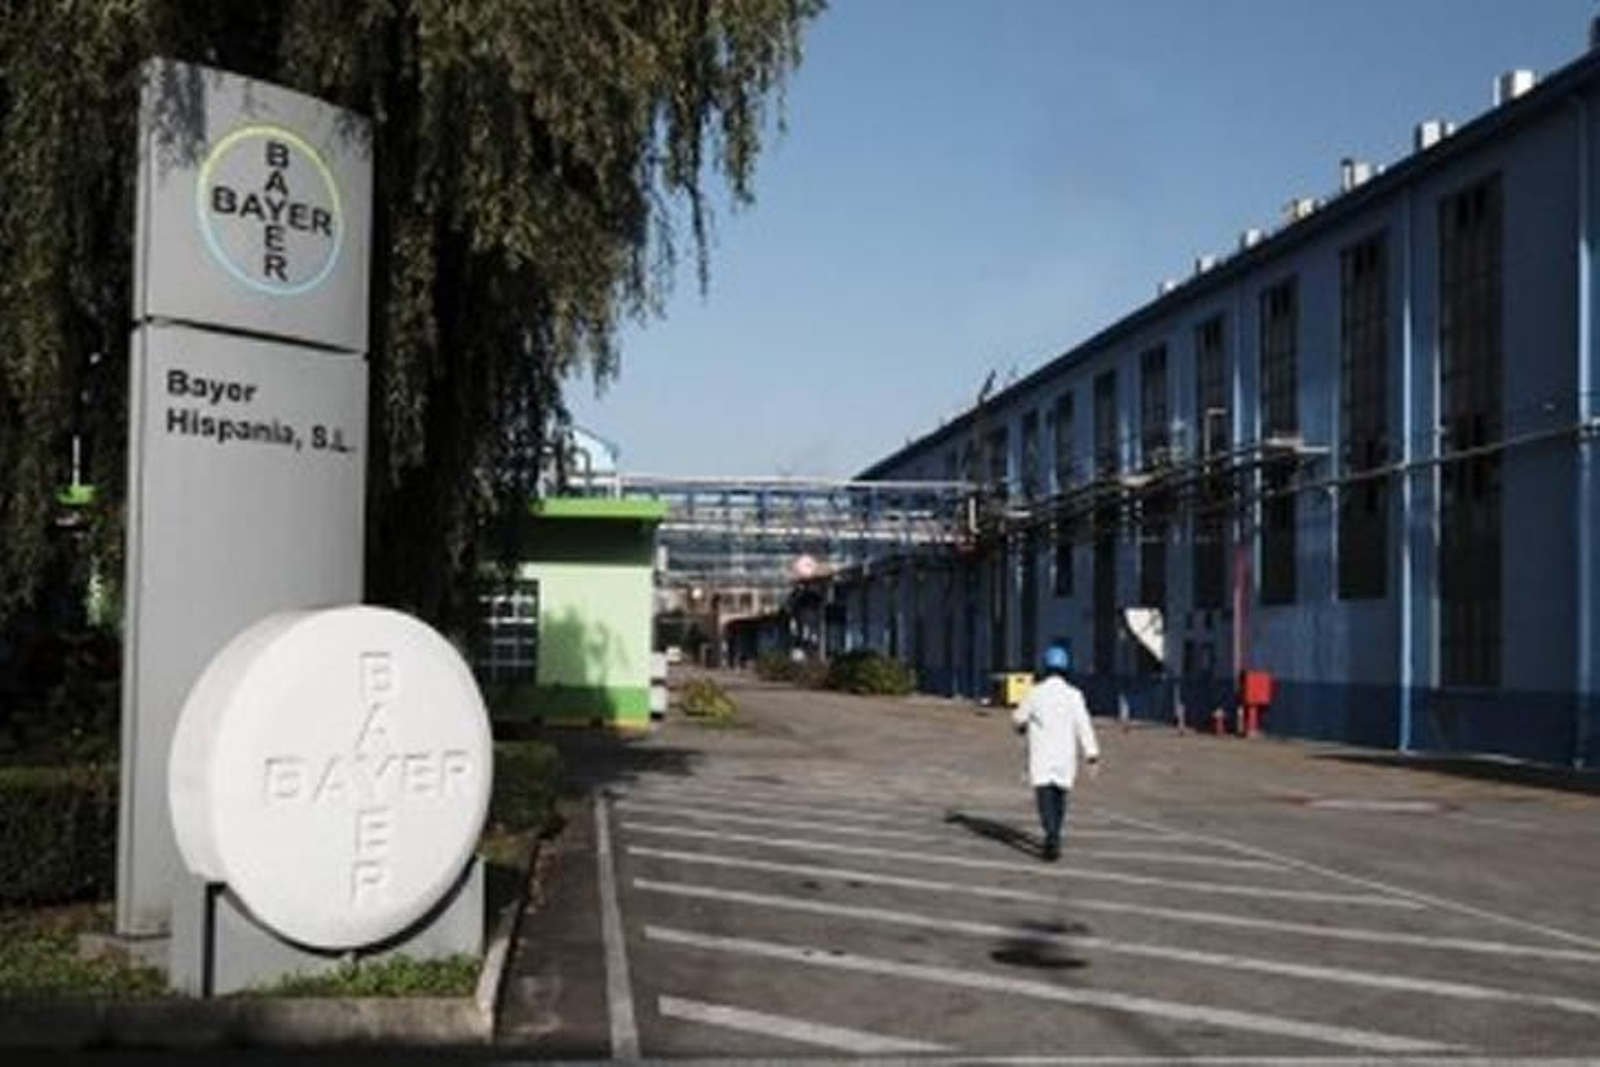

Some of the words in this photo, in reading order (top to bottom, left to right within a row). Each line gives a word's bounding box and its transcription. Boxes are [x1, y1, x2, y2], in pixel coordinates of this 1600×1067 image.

[212, 186, 332, 236] BAYER
[264, 141, 289, 282] BAYER
[166, 368, 257, 405] Bayer
[167, 408, 302, 451] Hispania,
[264, 750, 472, 804] BAYER
